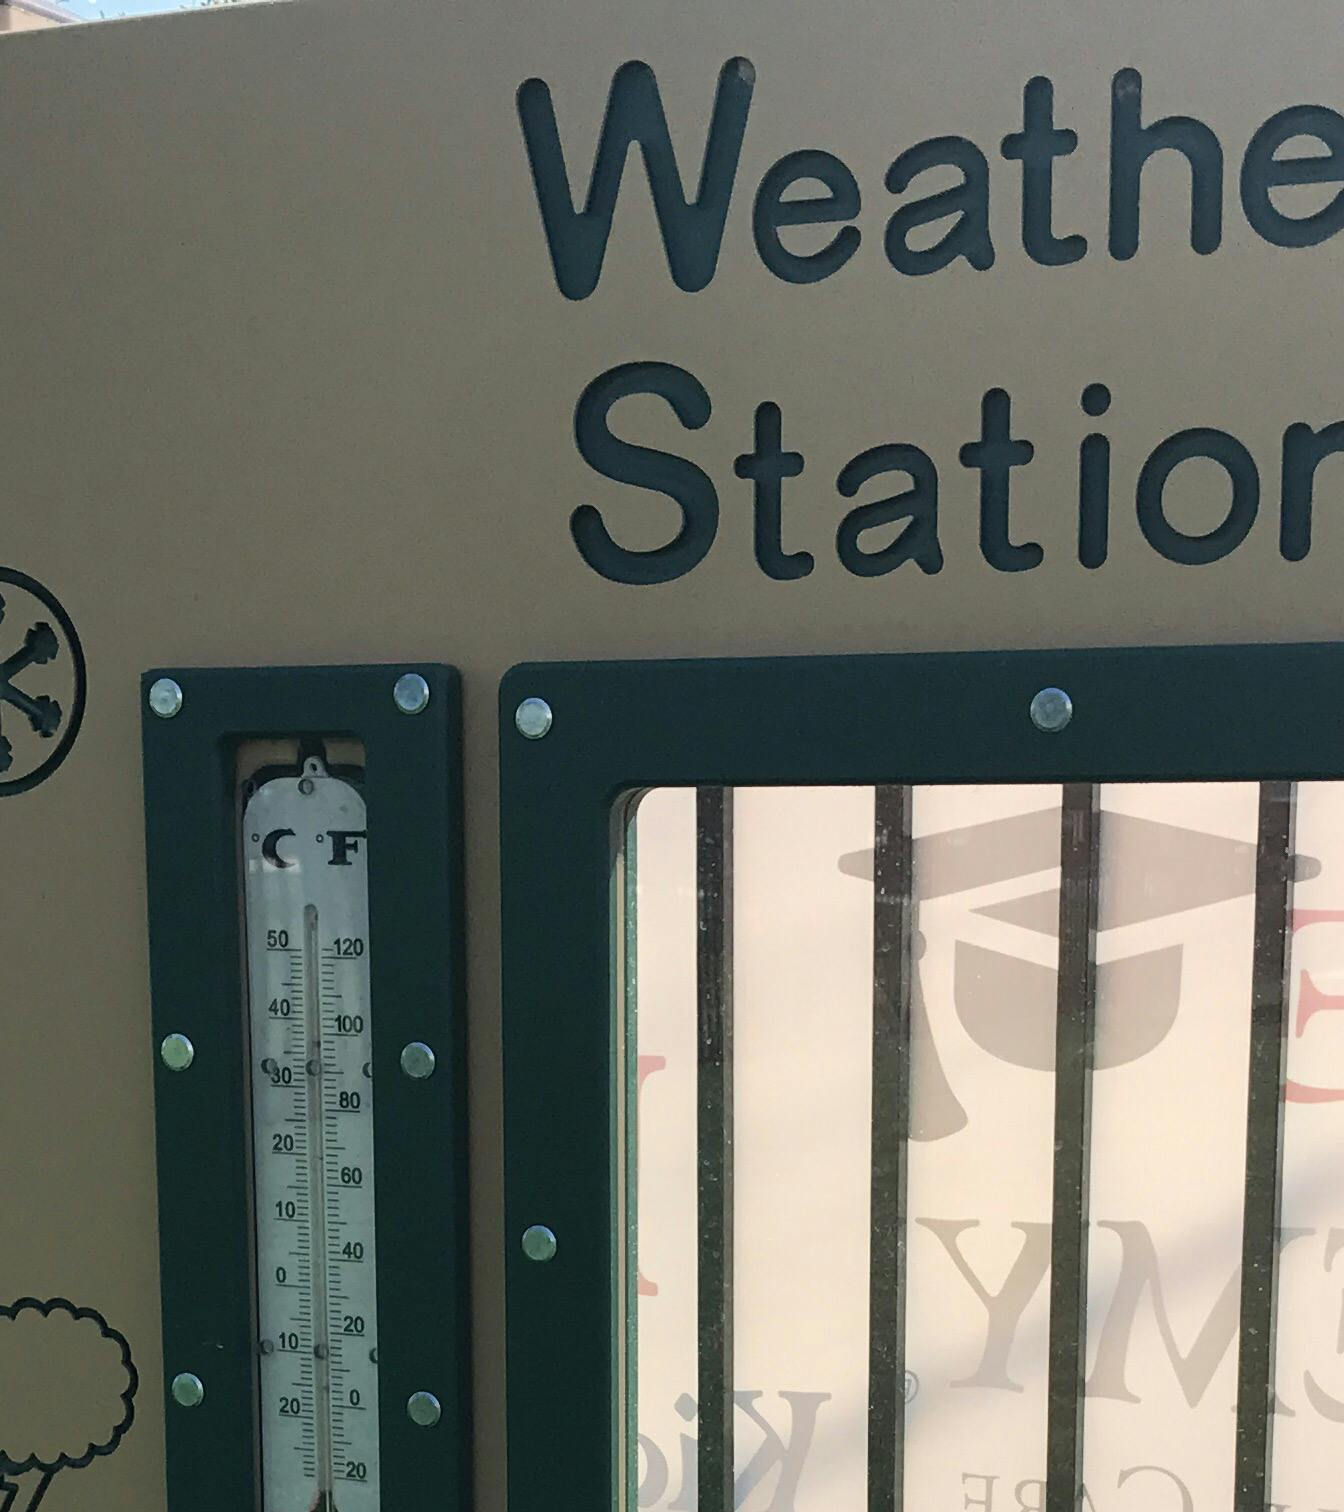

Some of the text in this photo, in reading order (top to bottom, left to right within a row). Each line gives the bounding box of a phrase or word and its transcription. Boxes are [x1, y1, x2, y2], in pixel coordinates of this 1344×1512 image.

[266, 929, 289, 948] 50
[332, 937, 364, 956] 120
[268, 998, 291, 1017] 40
[333, 1014, 364, 1033] 100
[270, 1066, 293, 1085] 30
[338, 1091, 361, 1110] 80
[272, 1133, 294, 1152] 20
[340, 1167, 363, 1185] 60
[275, 1200, 297, 1219] 10
[341, 1241, 364, 1260] 40
[275, 1266, 288, 1284] 0
[342, 1316, 366, 1334] 20
[278, 1332, 299, 1350] 10
[279, 1397, 301, 1415] 20
[348, 1389, 361, 1406] 0
[345, 1461, 367, 1479] 20
